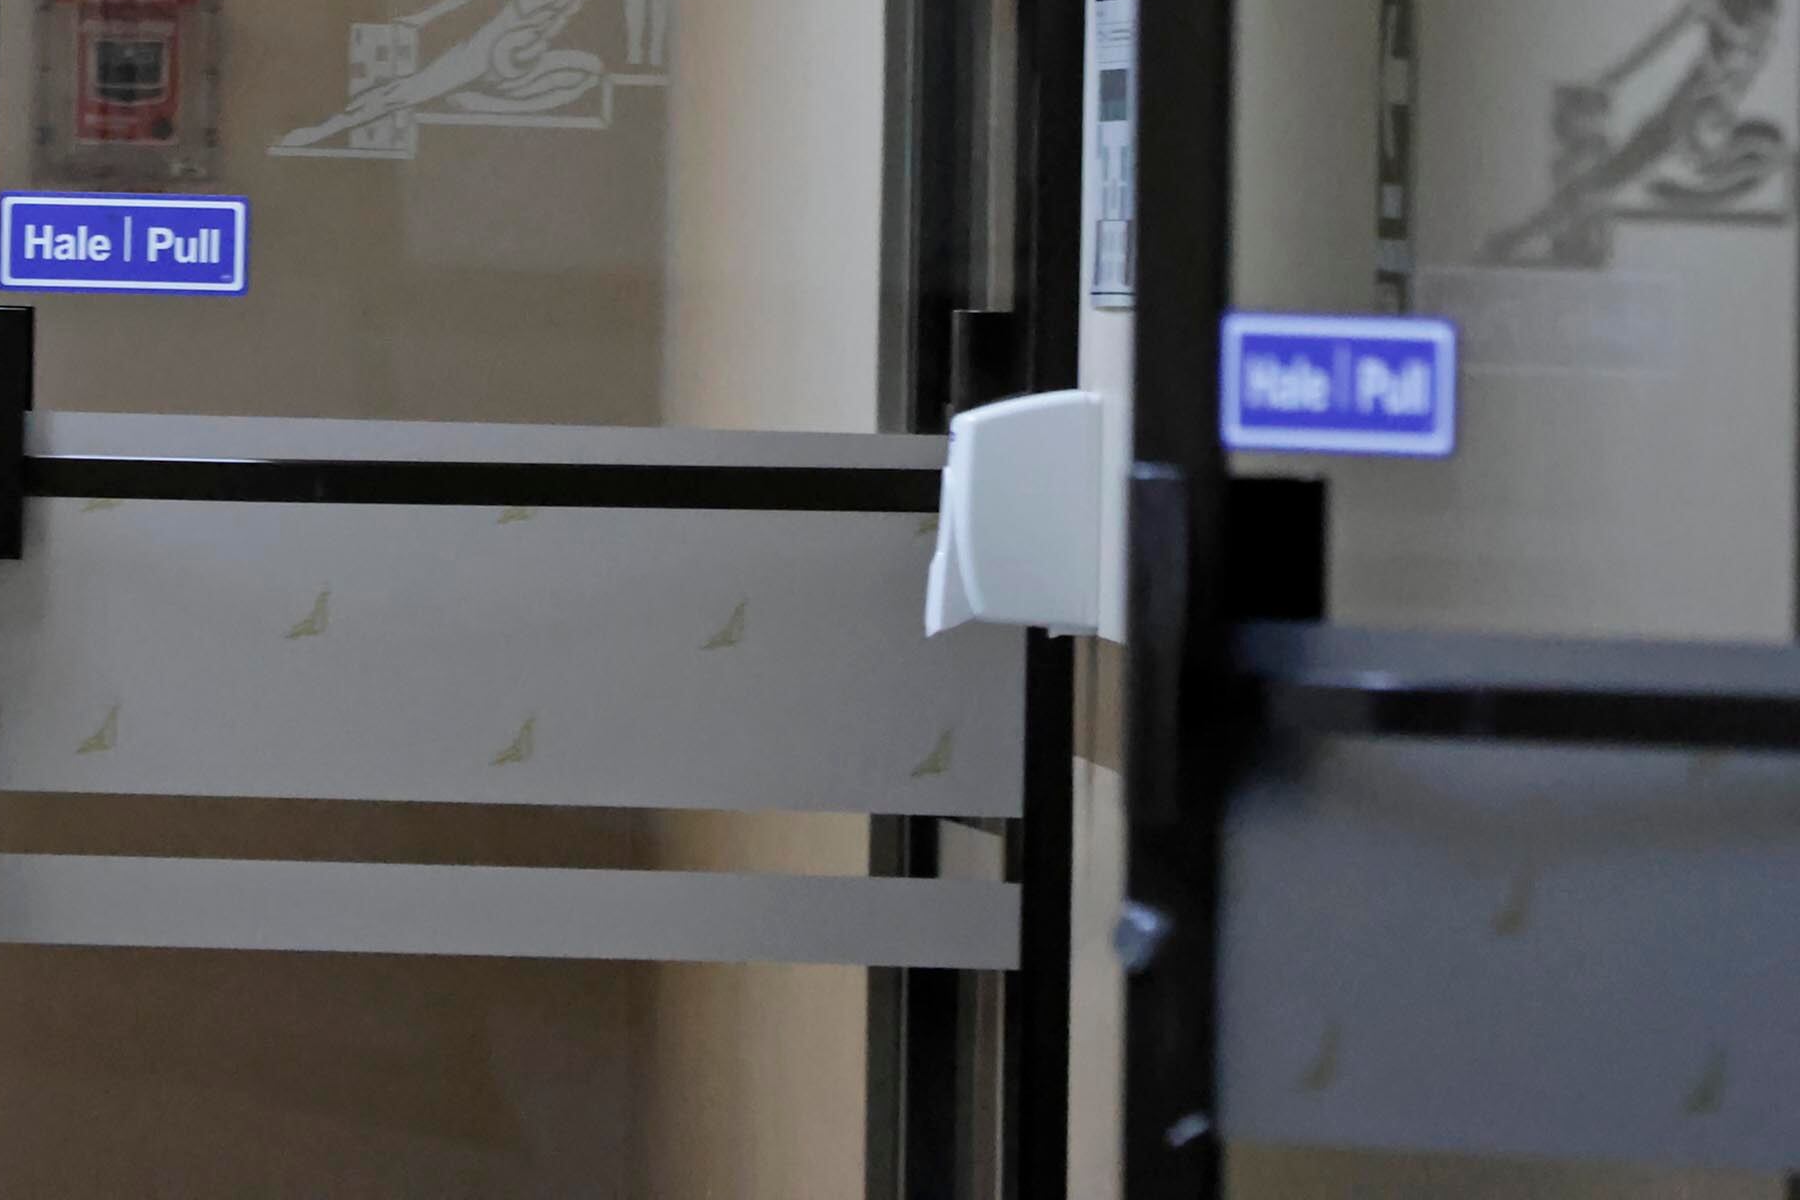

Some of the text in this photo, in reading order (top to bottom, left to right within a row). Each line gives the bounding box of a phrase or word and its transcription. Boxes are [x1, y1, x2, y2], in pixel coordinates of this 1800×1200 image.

[24, 224, 221, 263] Hale Pull
[1355, 356, 1431, 416] Pull
